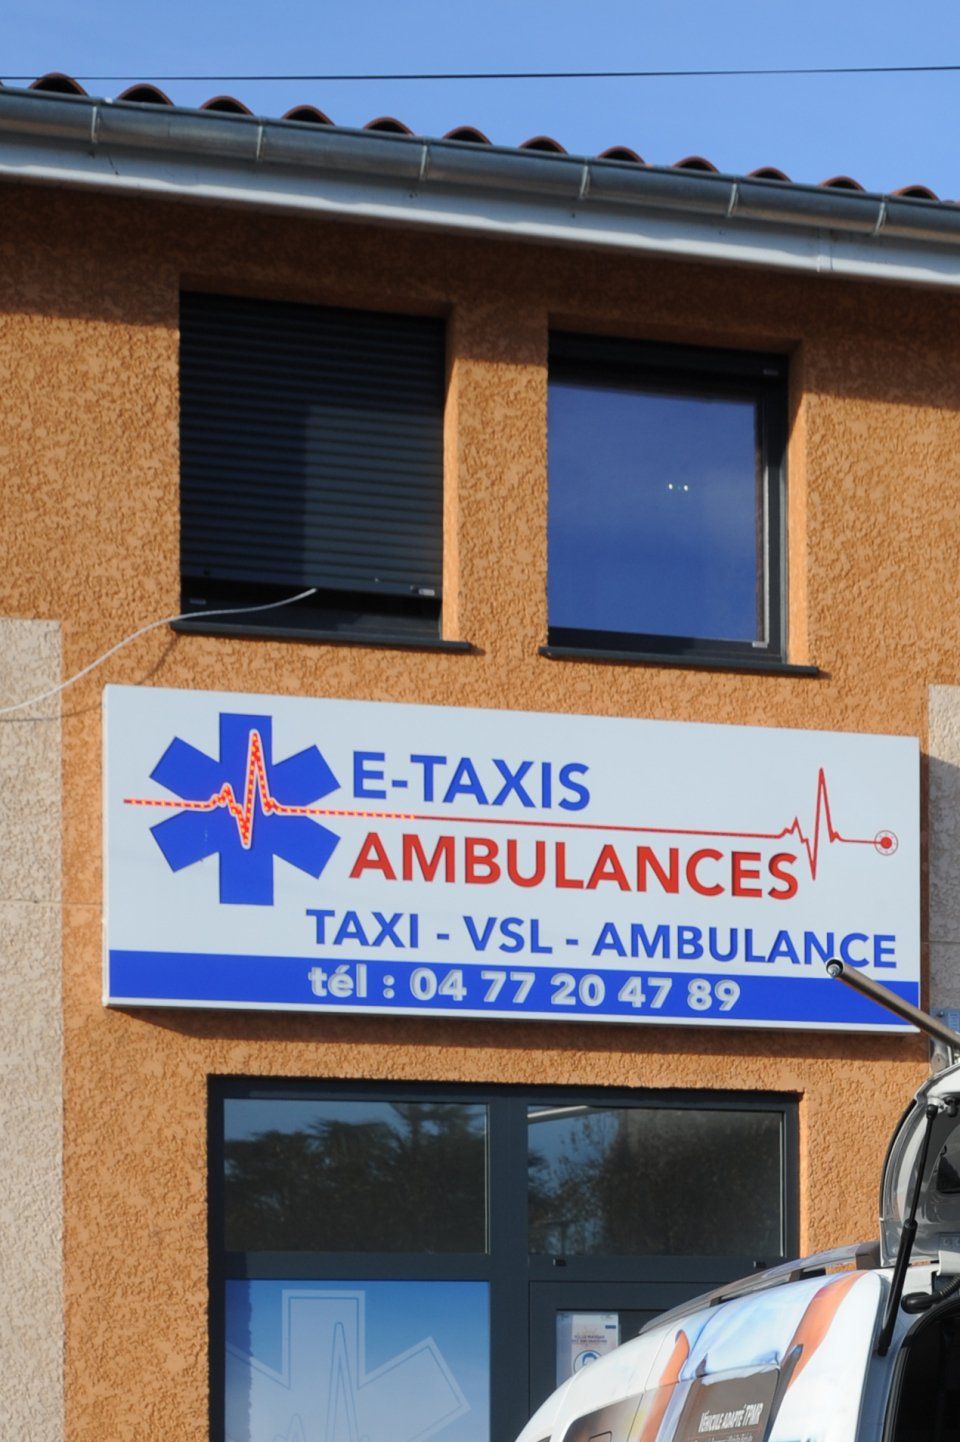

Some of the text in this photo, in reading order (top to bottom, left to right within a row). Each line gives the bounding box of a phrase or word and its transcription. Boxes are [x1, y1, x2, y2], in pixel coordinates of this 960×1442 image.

[353, 750, 590, 811] E-TAXIS
[351, 832, 799, 900] AMBULANCES
[306, 909, 419, 949] TAXI
[464, 915, 553, 954] VSL
[592, 922, 897, 968] AMBULANCE
[308, 964, 367, 998] tél
[410, 968, 467, 1001] 04
[481, 971, 536, 1004] 77
[550, 973, 606, 1007] 20
[617, 976, 673, 1008] 47
[687, 978, 742, 1011] 89
